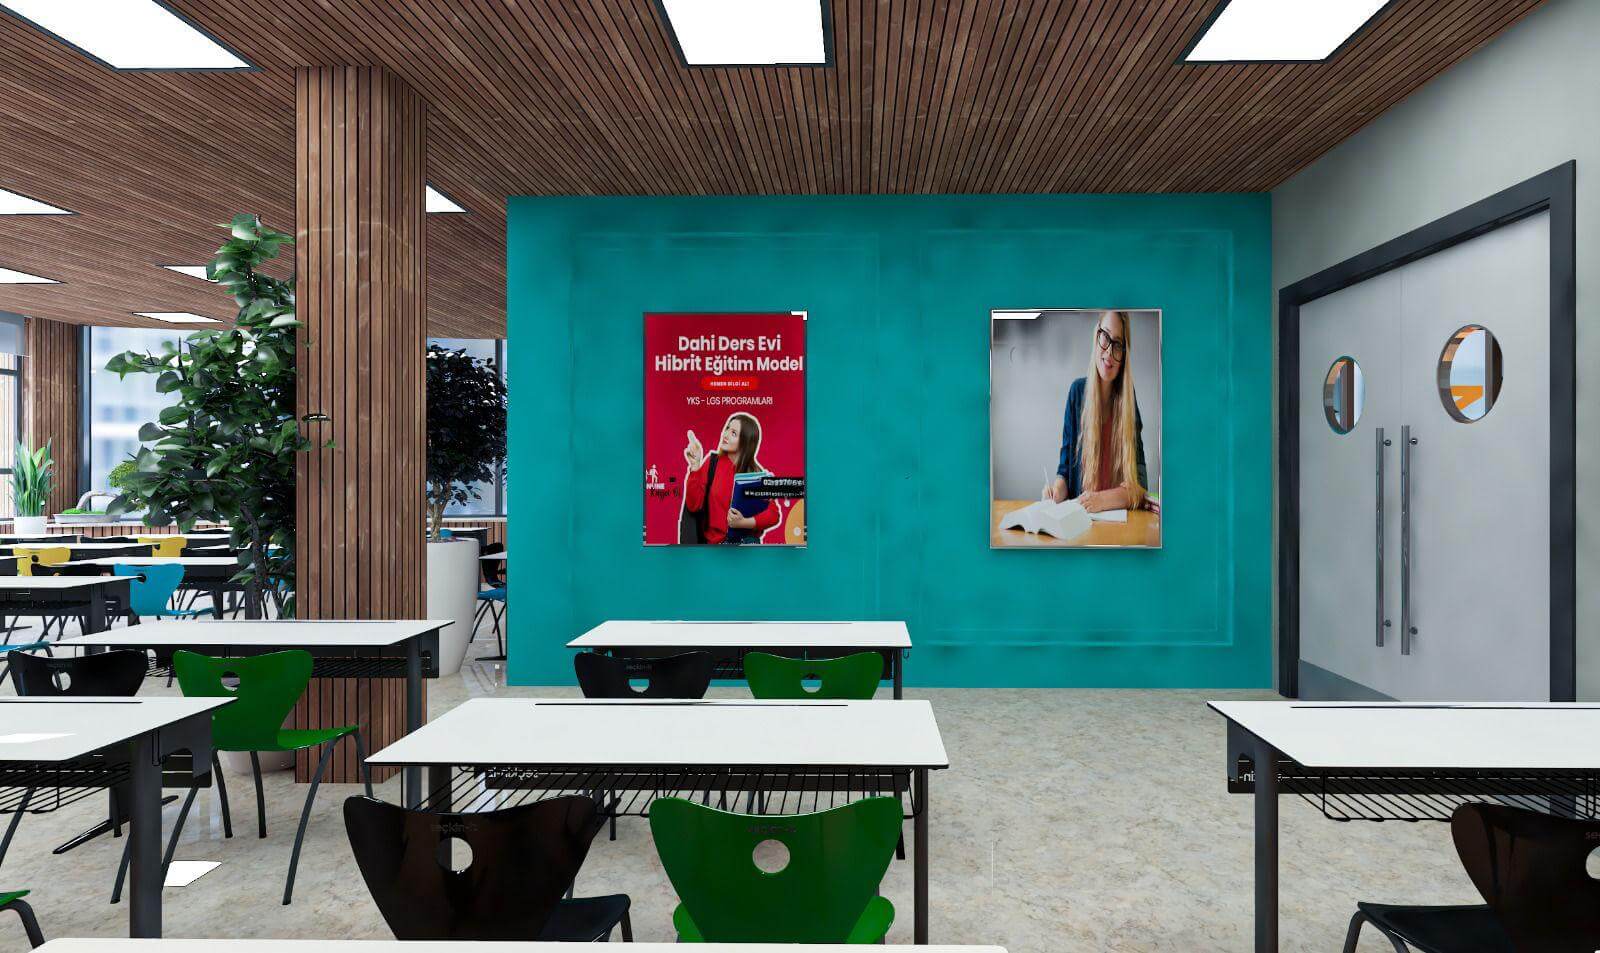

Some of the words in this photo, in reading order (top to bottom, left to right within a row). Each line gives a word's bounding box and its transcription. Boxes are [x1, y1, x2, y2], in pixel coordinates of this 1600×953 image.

[678, 334, 715, 351] Dahi
[718, 335, 755, 351] Ders
[758, 334, 781, 351] Evi
[655, 353, 702, 371] Hibrit
[705, 355, 754, 376] Eğitim
[756, 355, 804, 371] Model
[686, 396, 700, 405] YKS
[706, 396, 721, 405] LGS
[721, 396, 774, 405] PROGRAMLARI
